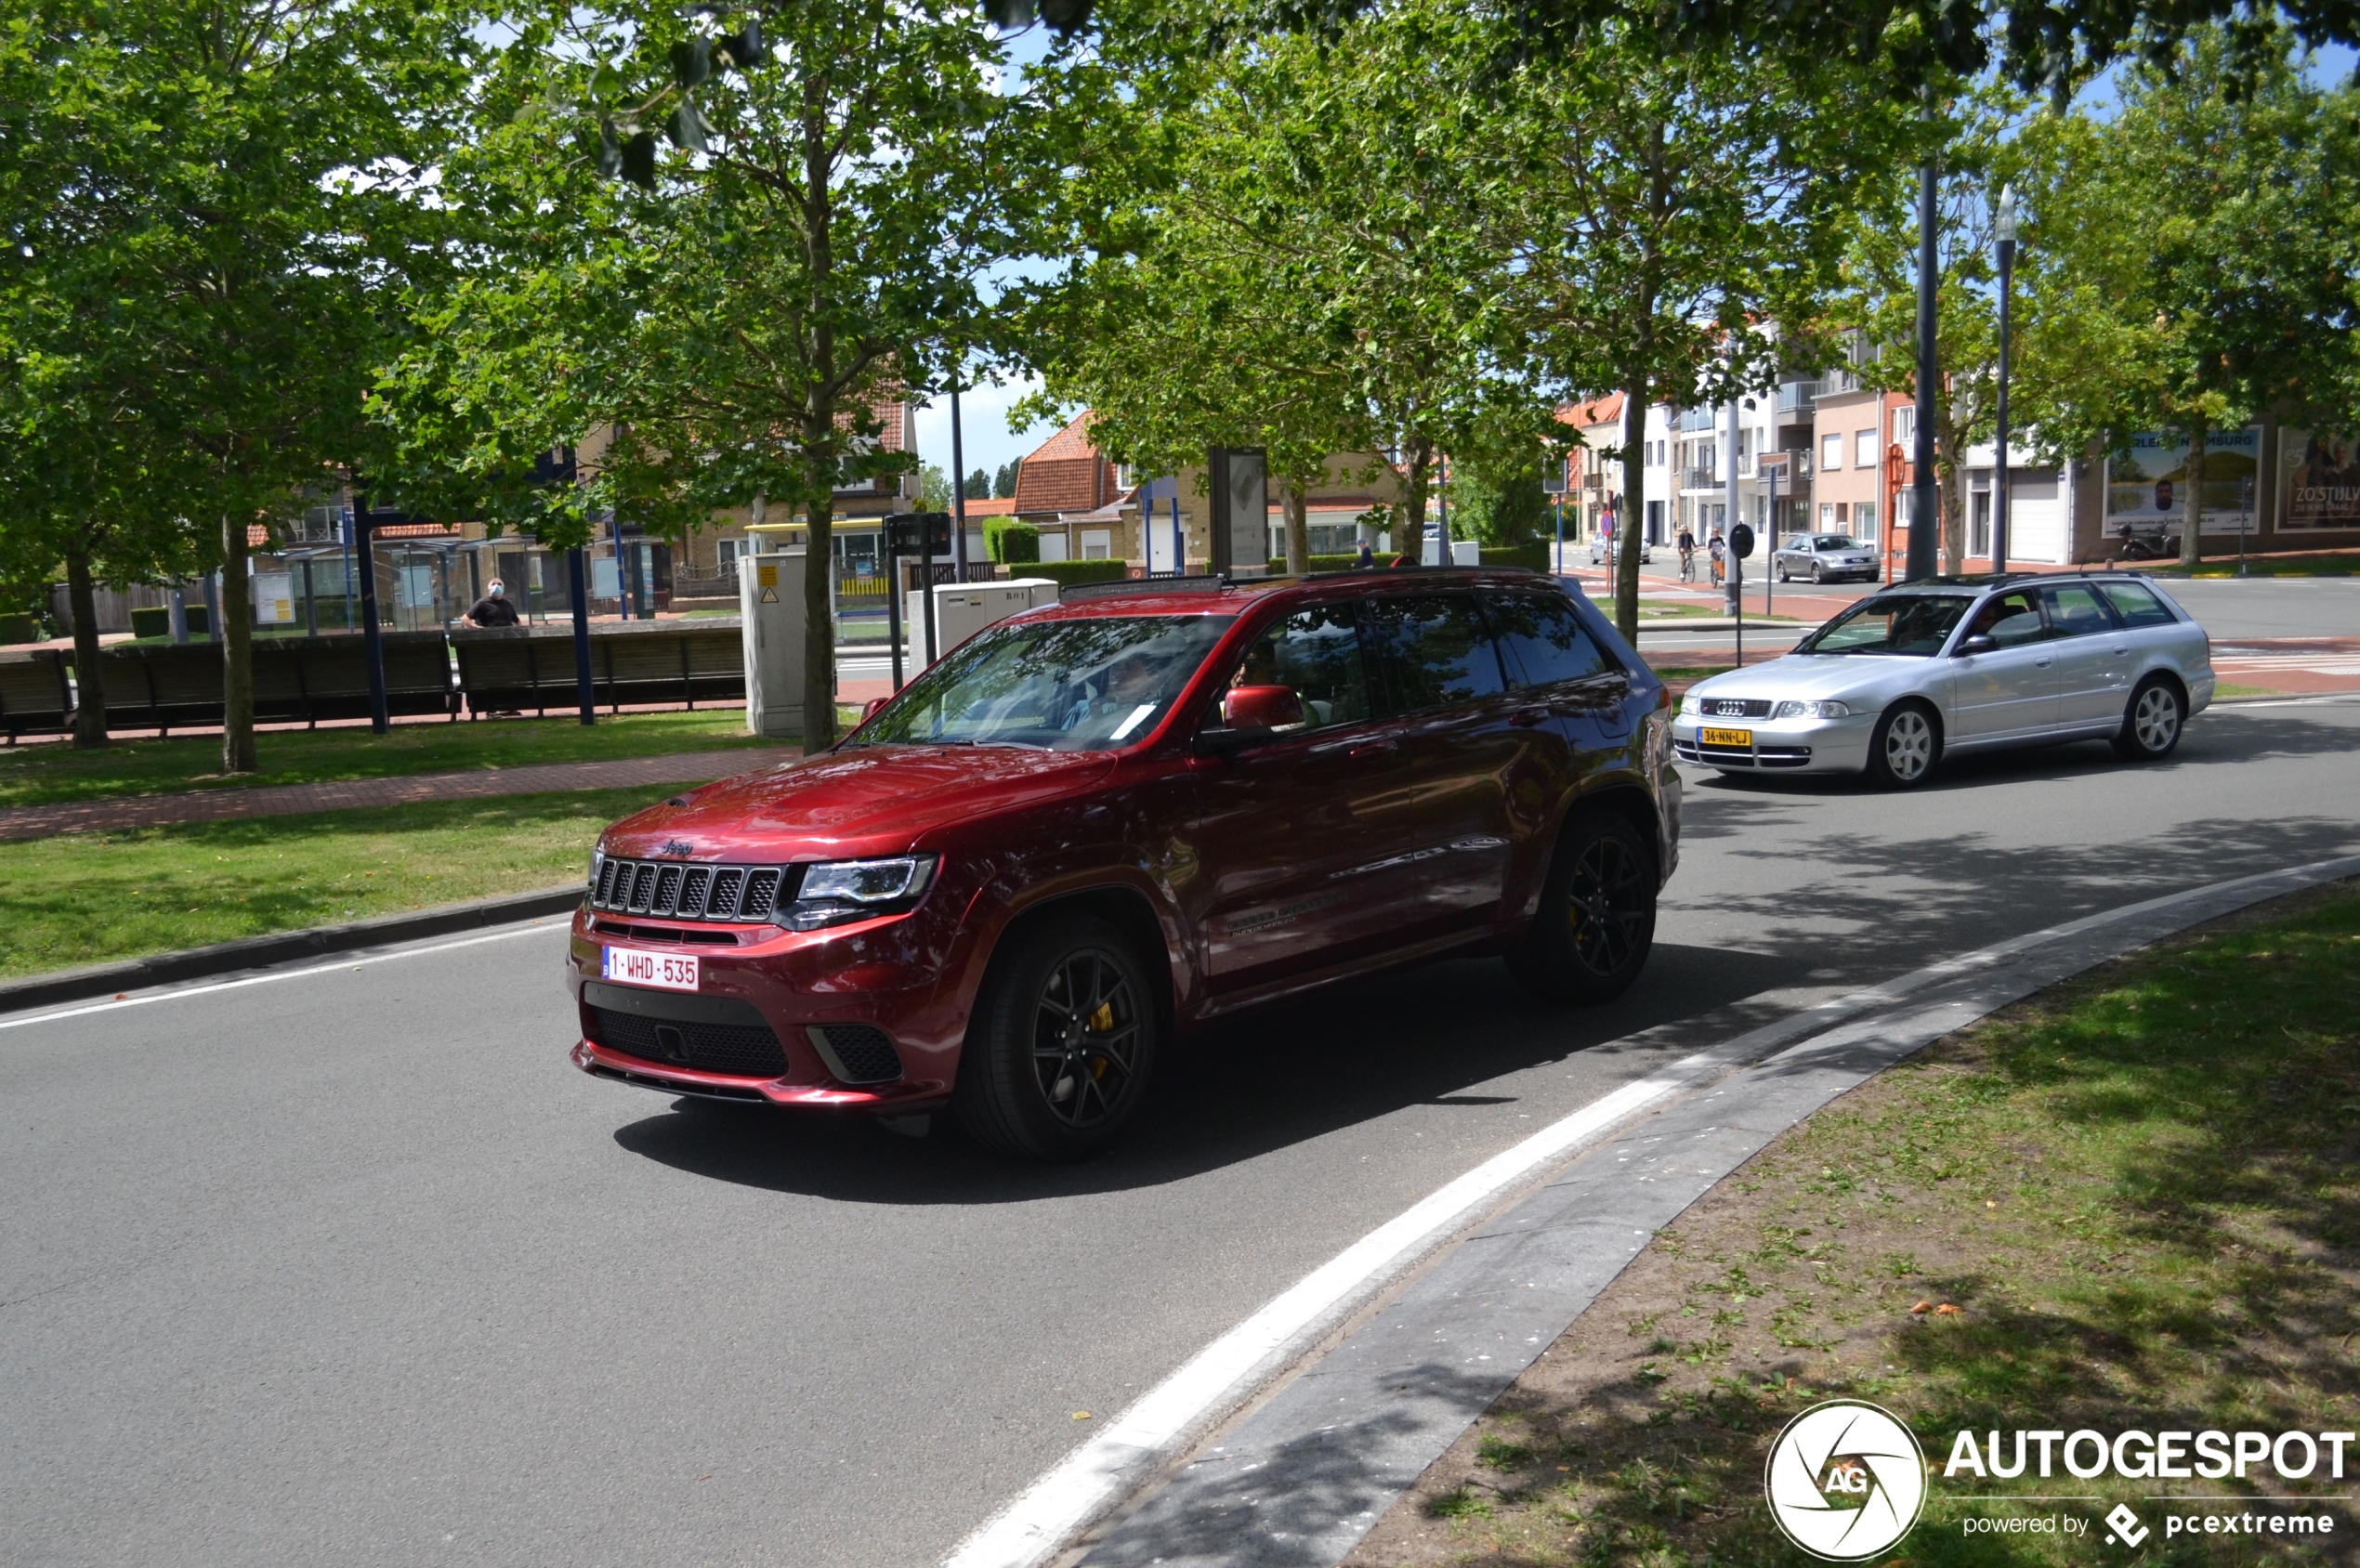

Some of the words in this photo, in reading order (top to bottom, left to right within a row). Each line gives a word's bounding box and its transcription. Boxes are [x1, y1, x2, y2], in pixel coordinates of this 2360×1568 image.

[2296, 487, 2316, 502] ZO
[1705, 730, 1747, 744] 36-NN-LJ
[661, 839, 693, 857] Jeep
